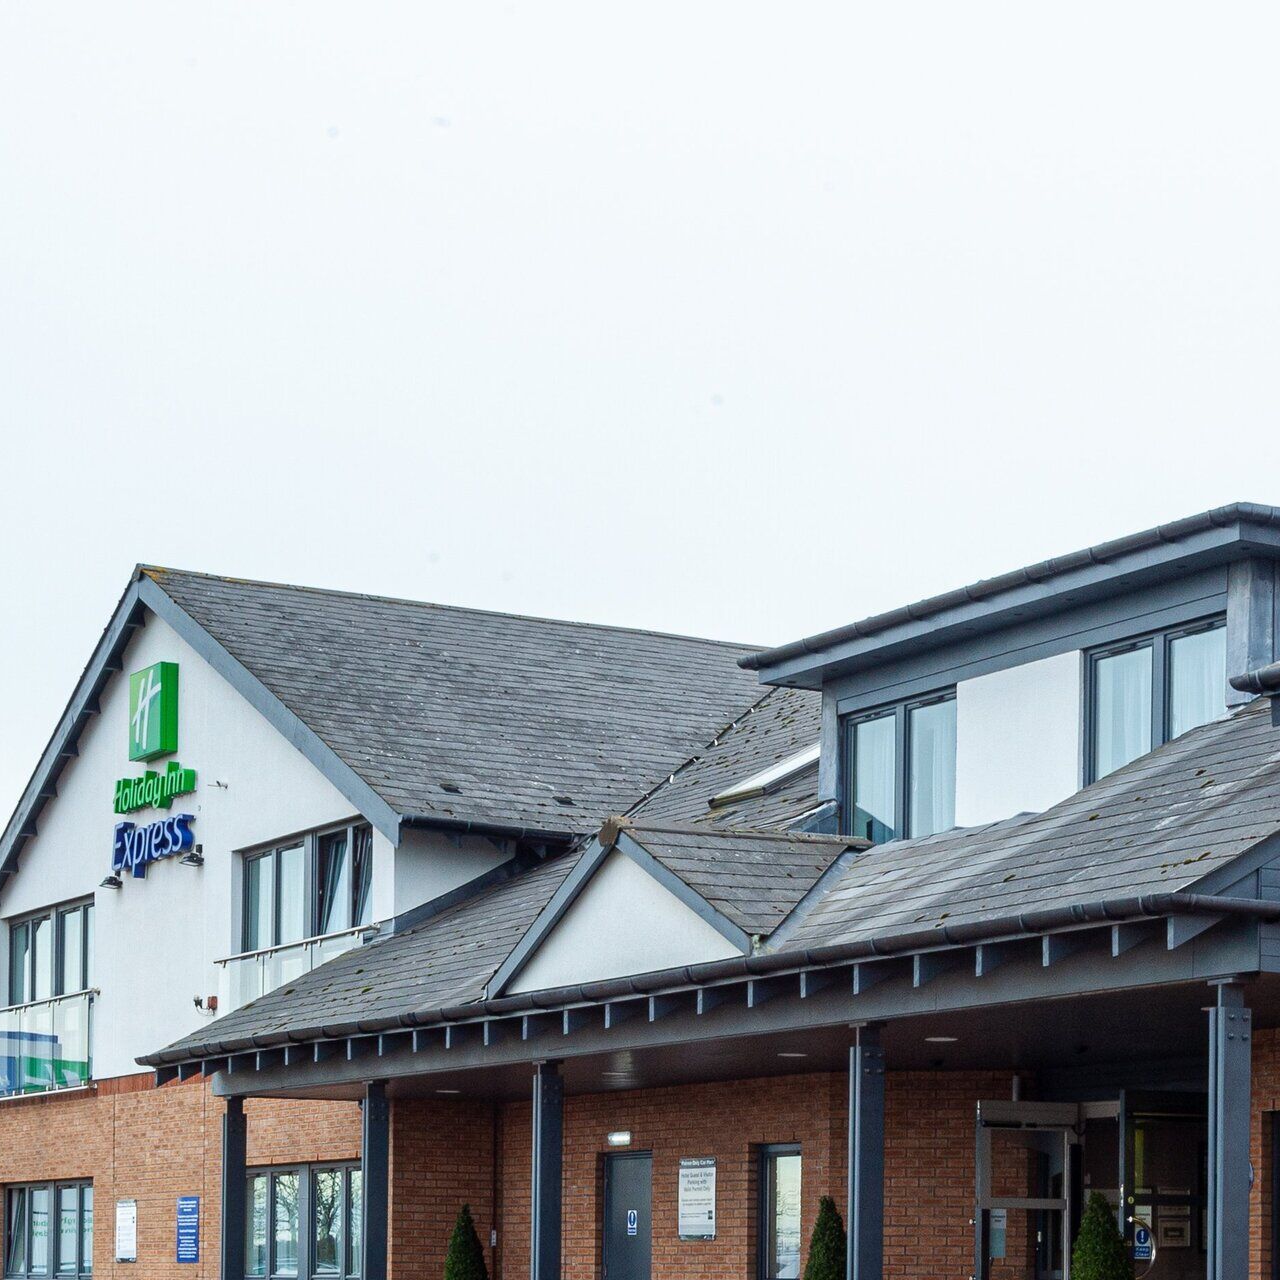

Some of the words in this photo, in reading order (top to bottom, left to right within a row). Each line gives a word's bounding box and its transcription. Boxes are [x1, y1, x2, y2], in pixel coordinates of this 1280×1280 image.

[114, 774, 162, 815] Holiday
[162, 766, 187, 798] Inn
[111, 814, 186, 871] Express
